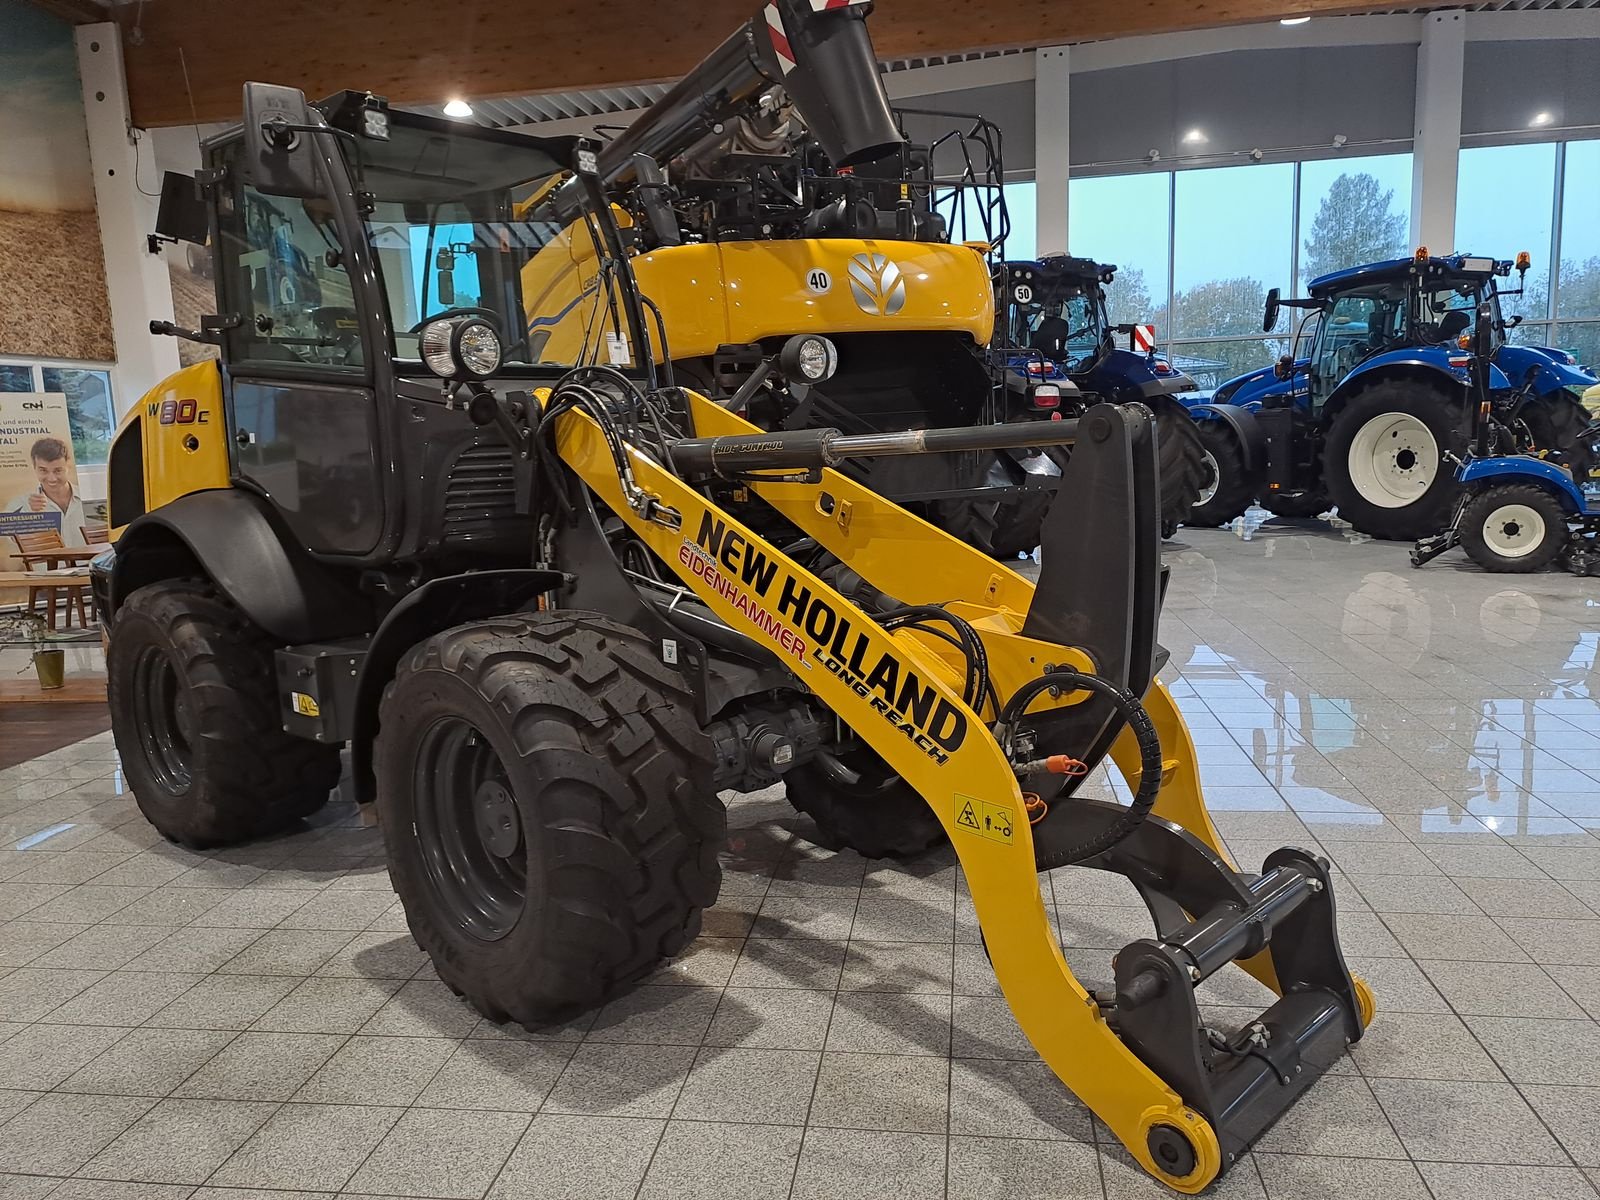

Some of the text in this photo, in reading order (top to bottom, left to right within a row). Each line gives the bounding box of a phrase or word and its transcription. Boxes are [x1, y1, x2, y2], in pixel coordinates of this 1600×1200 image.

[810, 272, 828, 289] 40
[1017, 288, 1030, 300] 50
[740, 440, 784, 453] CONTROL
[683, 536, 717, 567] Landtechnik
[679, 545, 807, 662] EIDENHAMMER
[696, 508, 968, 752] NEW HOLLAND
[812, 647, 950, 767] LONG REACH
